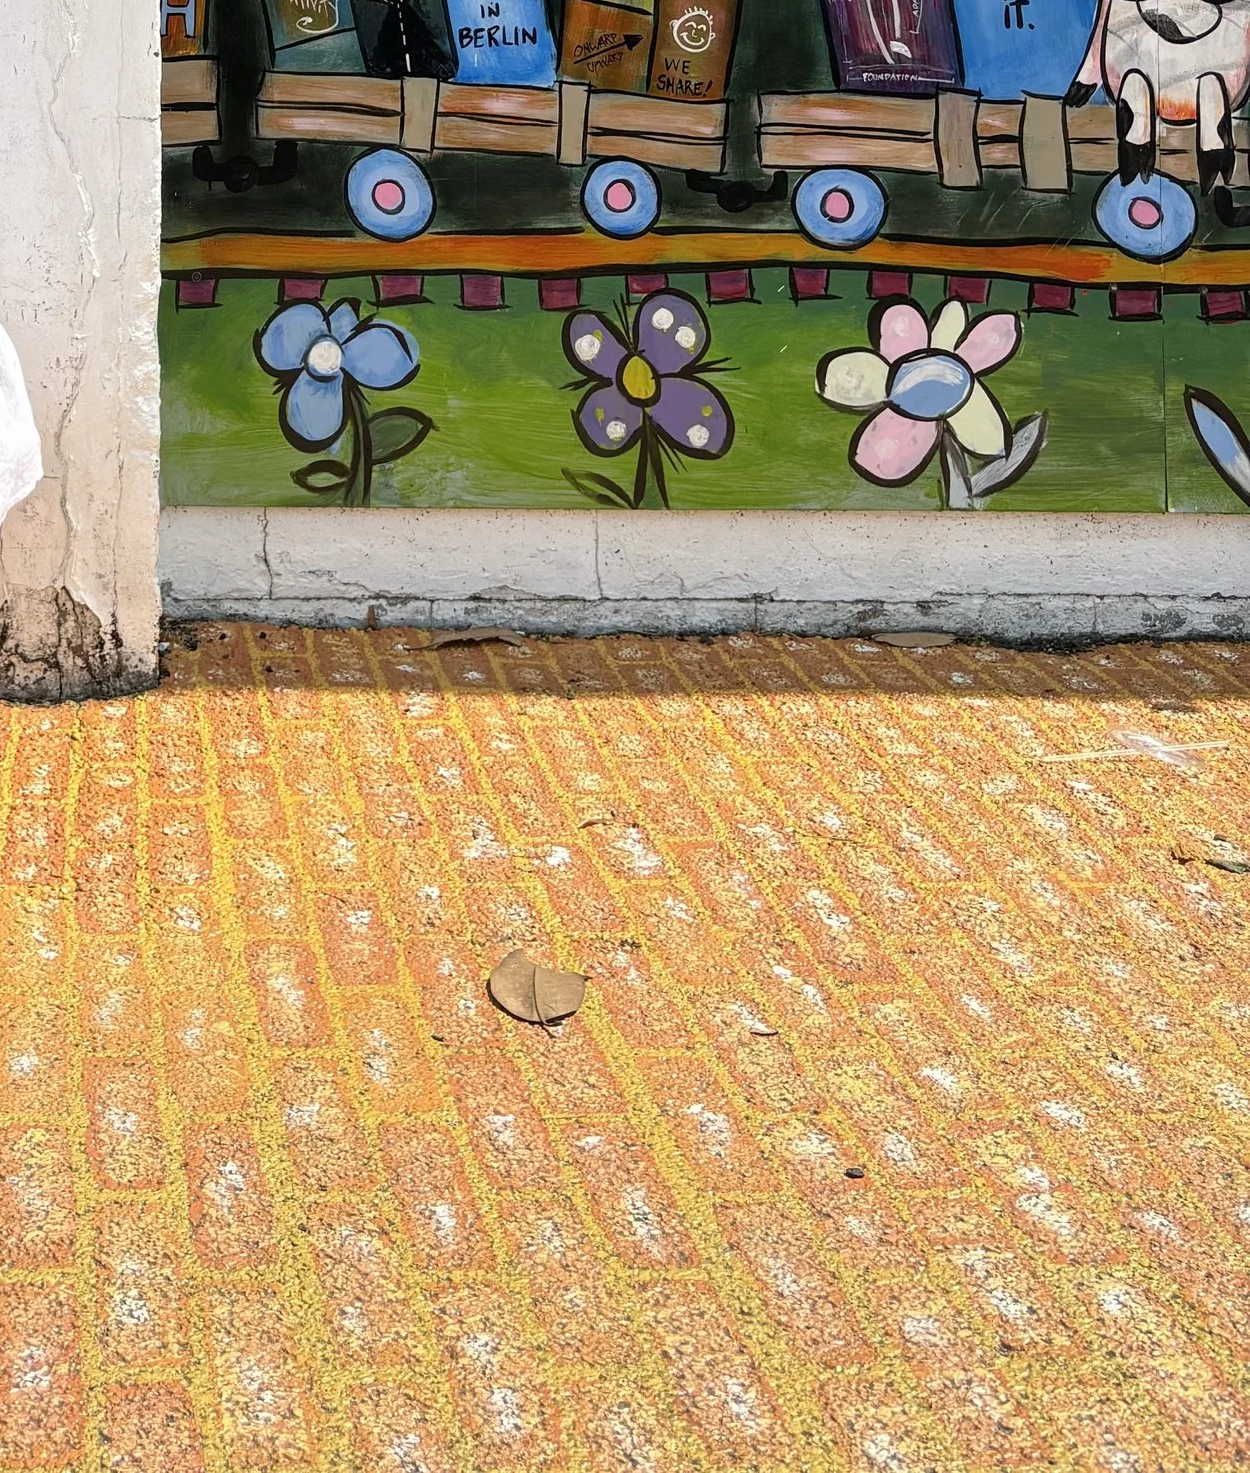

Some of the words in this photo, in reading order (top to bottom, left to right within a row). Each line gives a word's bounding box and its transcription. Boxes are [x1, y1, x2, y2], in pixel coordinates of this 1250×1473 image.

[480, 2, 500, 19] IN
[458, 24, 538, 49] BERLIN
[663, 57, 692, 76] WE
[655, 72, 714, 99] SHARE!
